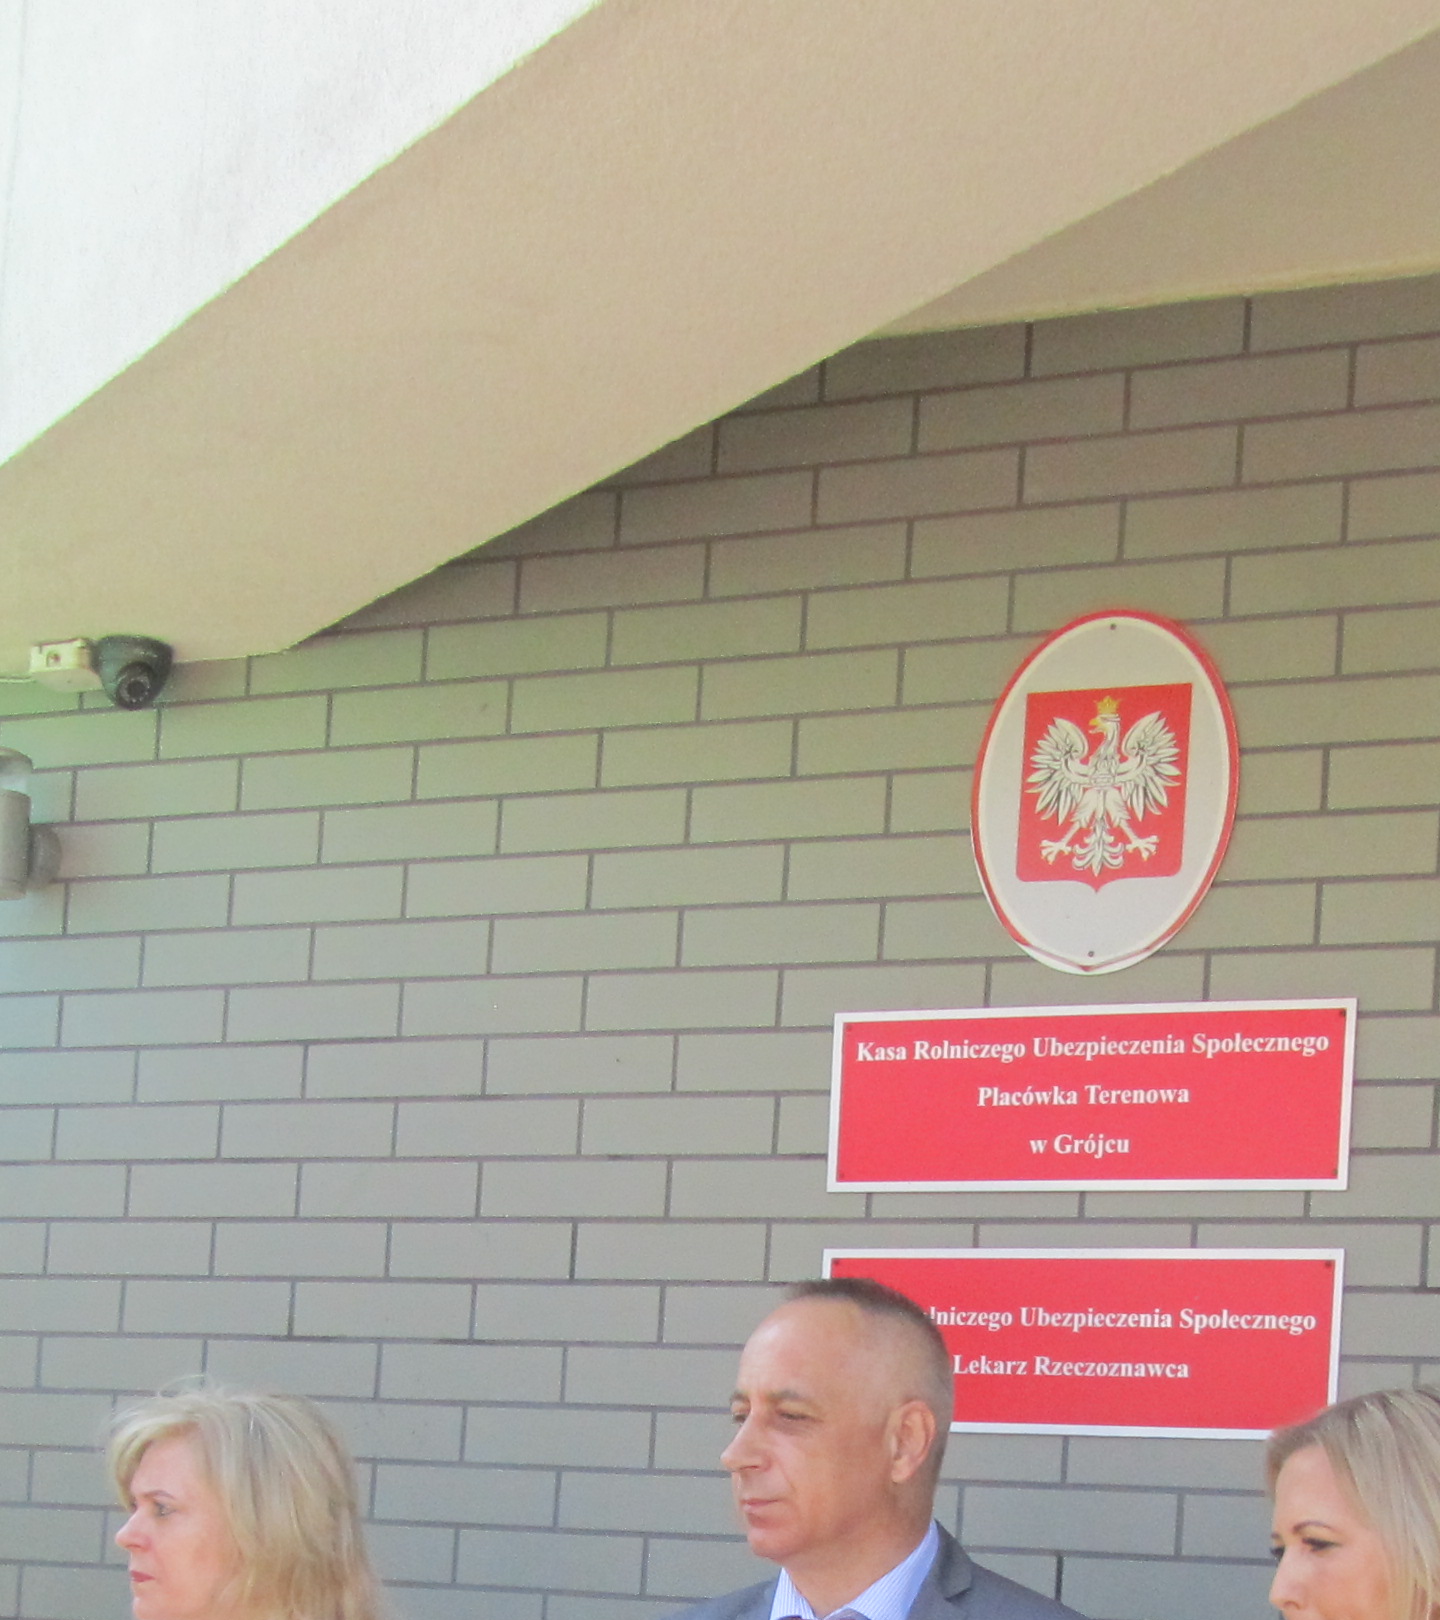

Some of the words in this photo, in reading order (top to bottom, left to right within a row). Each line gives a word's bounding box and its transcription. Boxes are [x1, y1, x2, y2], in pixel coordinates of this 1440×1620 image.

[856, 1042, 907, 1062] Kasa
[913, 1039, 1026, 1064] Rolniczego
[1033, 1034, 1185, 1061] Ubezpieczenia
[1192, 1032, 1330, 1059] Społecznego
[977, 1085, 1078, 1107] Placówka
[1085, 1084, 1190, 1105] Terenowa
[1029, 1139, 1048, 1154] w
[1053, 1133, 1130, 1159] Grójcu
[924, 1306, 1013, 1332] lniczego
[1020, 1307, 1173, 1333] Ubezpieczenia
[1179, 1308, 1317, 1335] Społecznego
[952, 1354, 1028, 1375] Lekarz
[1033, 1356, 1189, 1378] Rzeczoznawca
